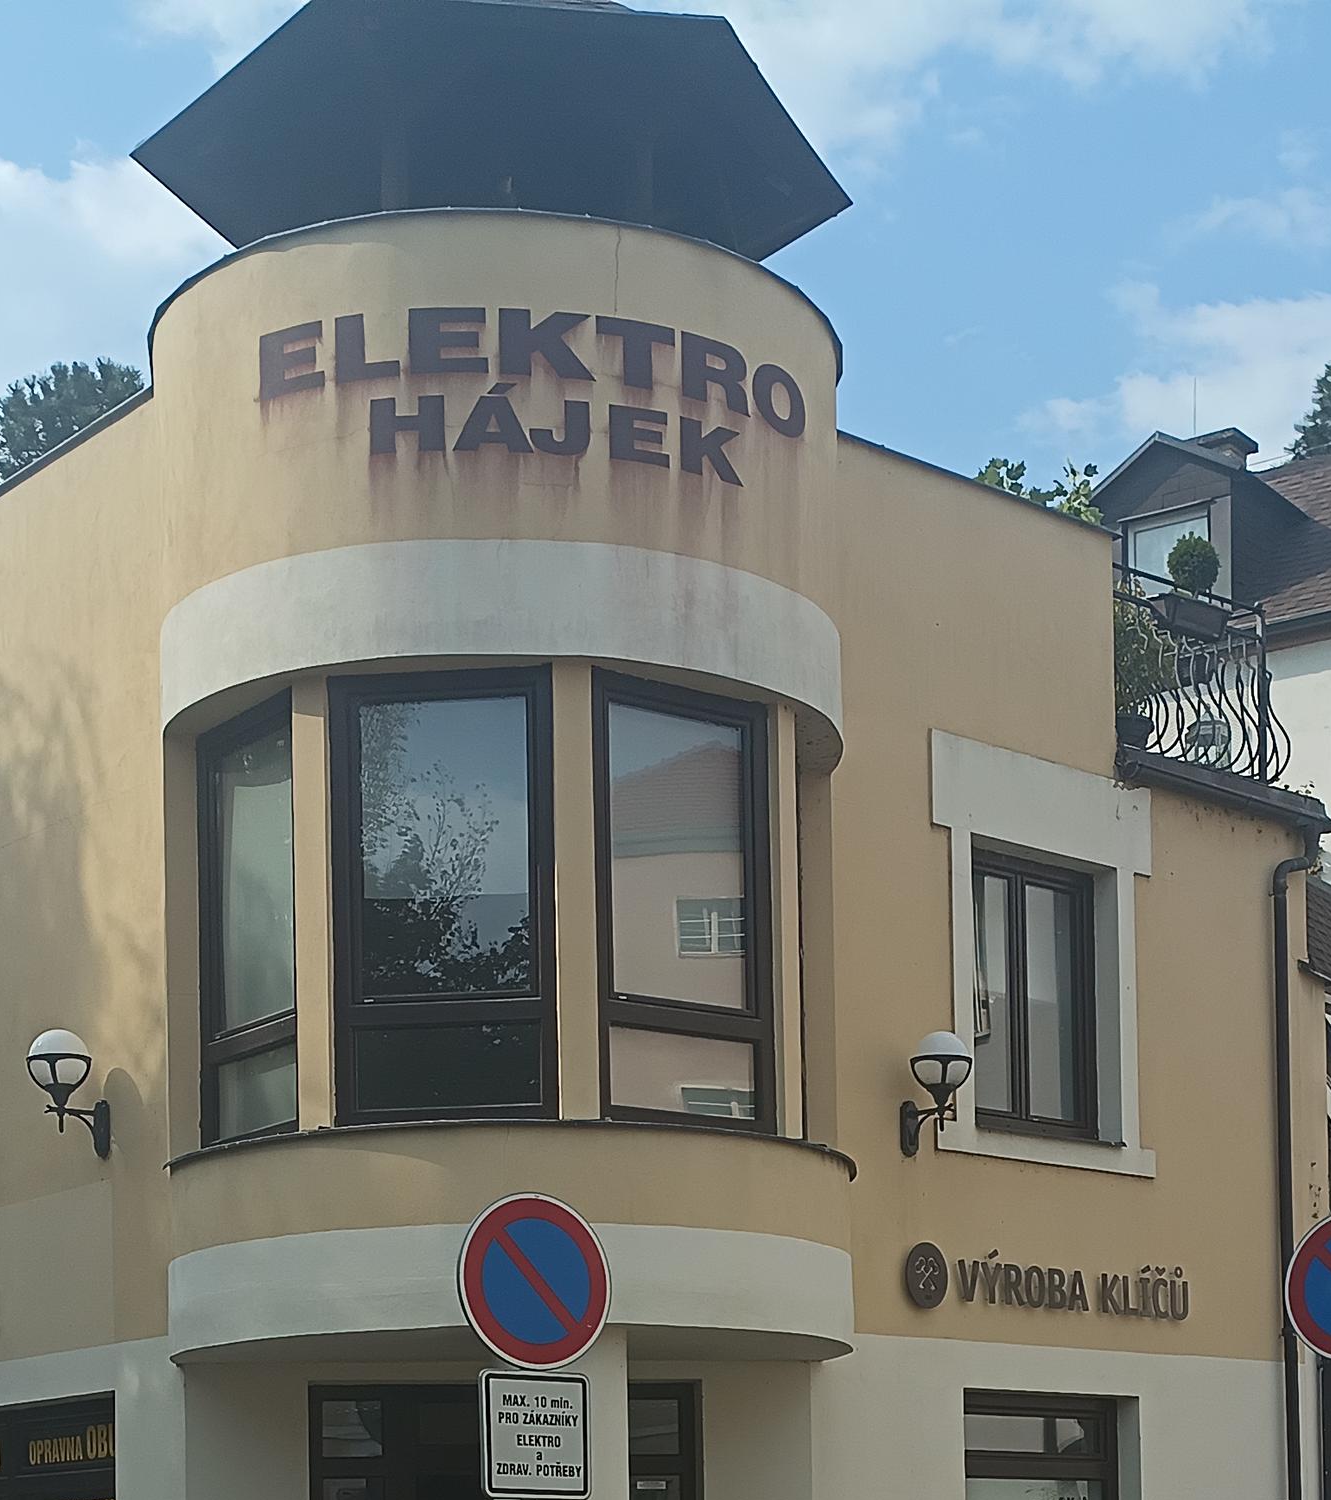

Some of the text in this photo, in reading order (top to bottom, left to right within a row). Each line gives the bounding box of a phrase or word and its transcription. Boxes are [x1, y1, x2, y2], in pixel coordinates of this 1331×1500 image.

[258, 306, 806, 439] ELEKTRO
[368, 382, 745, 488] HÁJEK
[957, 1248, 1190, 1321] VÝROBA KLÍČŮ
[502, 1394, 573, 1409] MAX. 10 min.
[498, 1410, 578, 1427] PRO ZÁKAZNÍKY
[516, 1434, 561, 1448] ELEKTRO
[29, 1436, 84, 1465] OPRAVNA
[536, 1451, 543, 1461] a
[496, 1462, 582, 1477] ZDRAV. POTŘEBY
